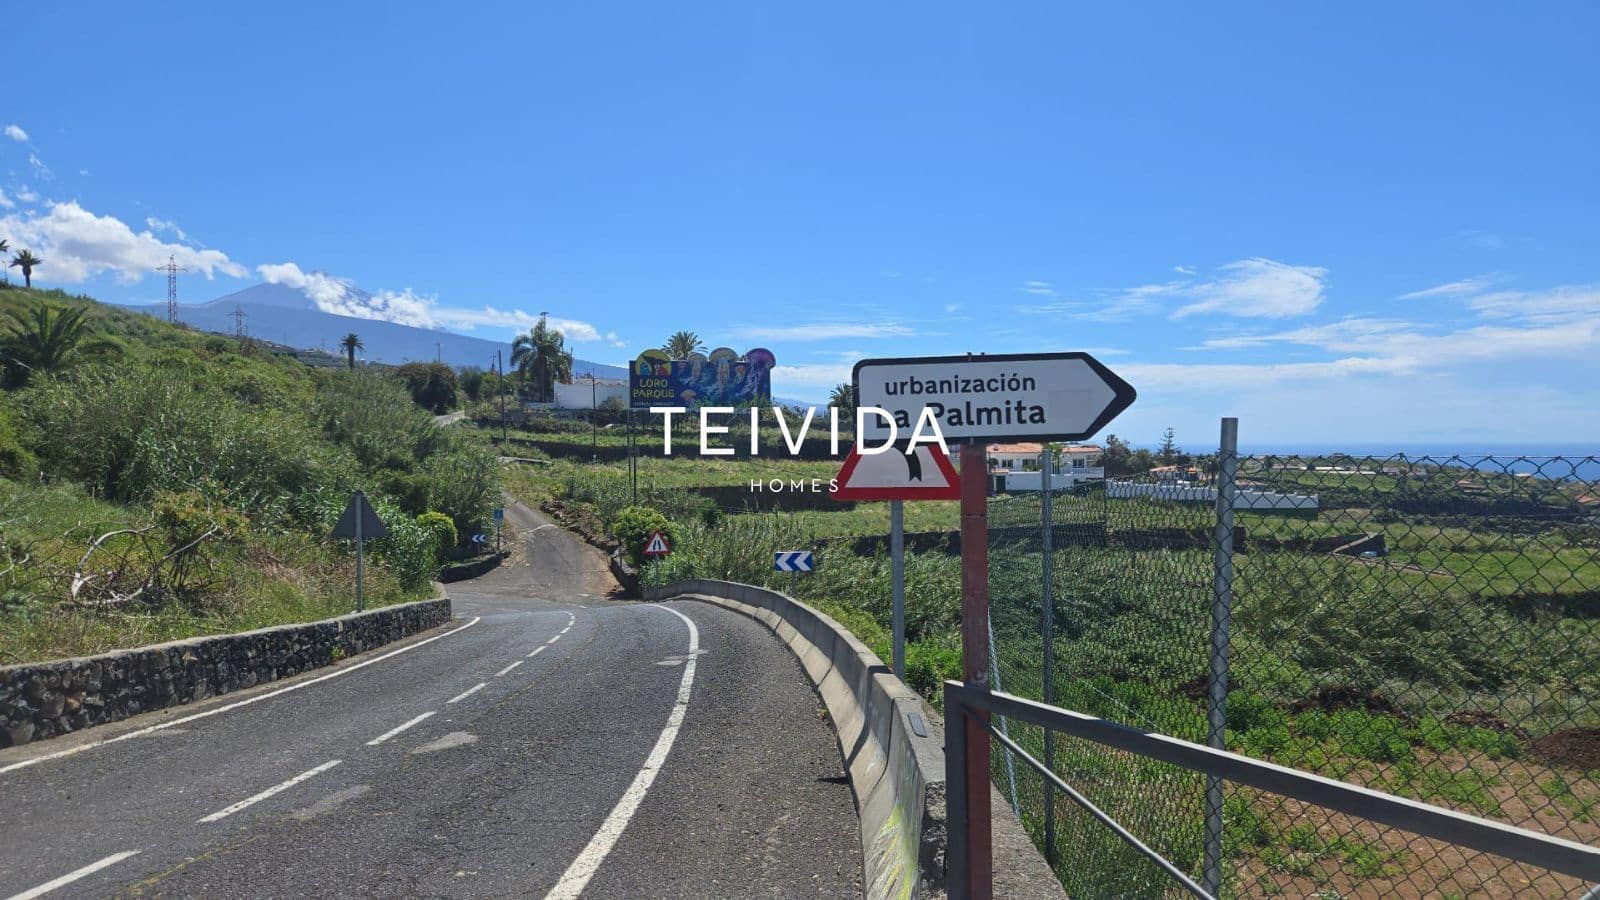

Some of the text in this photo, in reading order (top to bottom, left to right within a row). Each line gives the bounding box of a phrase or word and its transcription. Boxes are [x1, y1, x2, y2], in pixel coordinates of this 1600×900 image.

[639, 378, 669, 388] LORO
[885, 374, 1036, 395] urbanización
[633, 388, 675, 399] PARQUE
[926, 400, 1046, 427] Palmita
